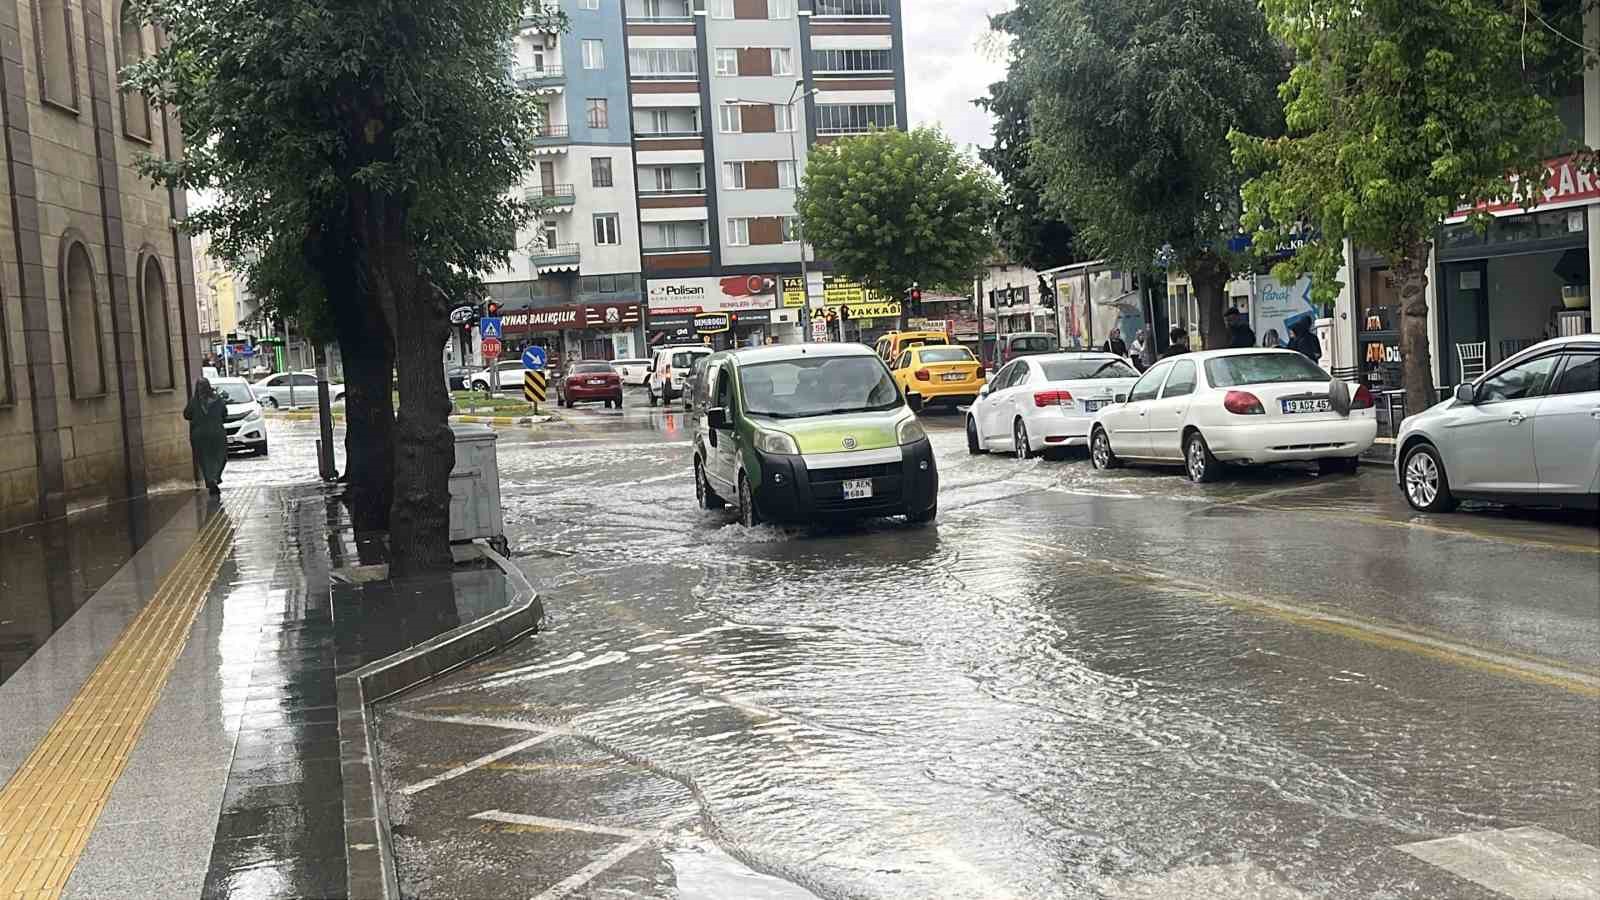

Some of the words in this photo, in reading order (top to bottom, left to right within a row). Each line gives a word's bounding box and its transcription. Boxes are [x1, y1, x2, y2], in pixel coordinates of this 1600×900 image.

[666, 284, 704, 296] Polisan
[849, 304, 901, 316] YAKKABI
[529, 311, 577, 326] BALIKÇILIK
[1366, 316, 1382, 330] ATA
[482, 343, 500, 352] DUR
[1299, 401, 1315, 410] ADZ
